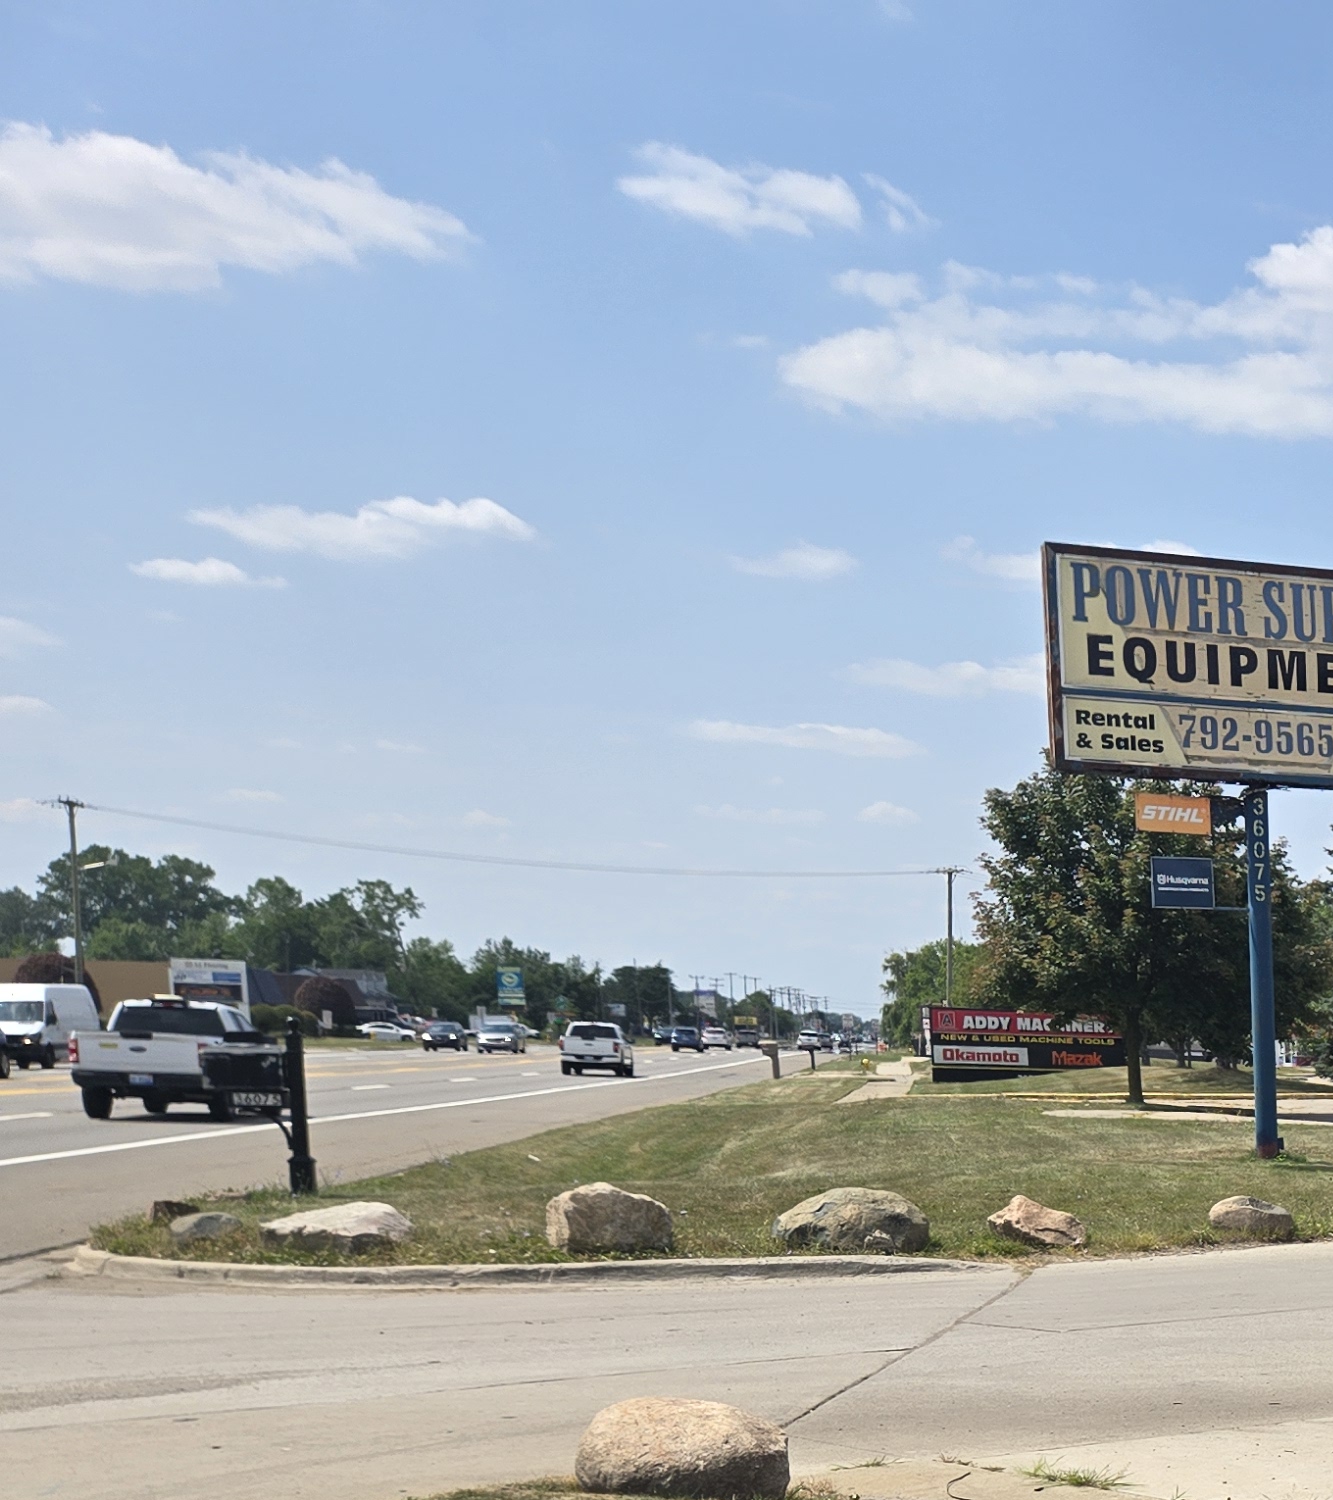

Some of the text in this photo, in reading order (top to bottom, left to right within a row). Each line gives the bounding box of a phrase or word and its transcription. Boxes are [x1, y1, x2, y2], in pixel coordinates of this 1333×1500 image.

[1070, 562, 1248, 636] POWER
[1075, 709, 1155, 730] Rental
[1076, 732, 1164, 753] & Sales
[1179, 714, 1333, 757] 792-9565
[1142, 805, 1204, 823] STIHL
[1252, 797, 1266, 902] 36075
[1166, 876, 1209, 885] Husqvarna
[963, 1015, 1011, 1031] ADDY
[940, 1033, 968, 1042] NEW
[983, 1035, 1016, 1043] USED
[1019, 1036, 1074, 1045] MACHINE
[1077, 1038, 1115, 1046] TOOLS
[942, 1048, 1104, 1066] Okamoto Mazak
